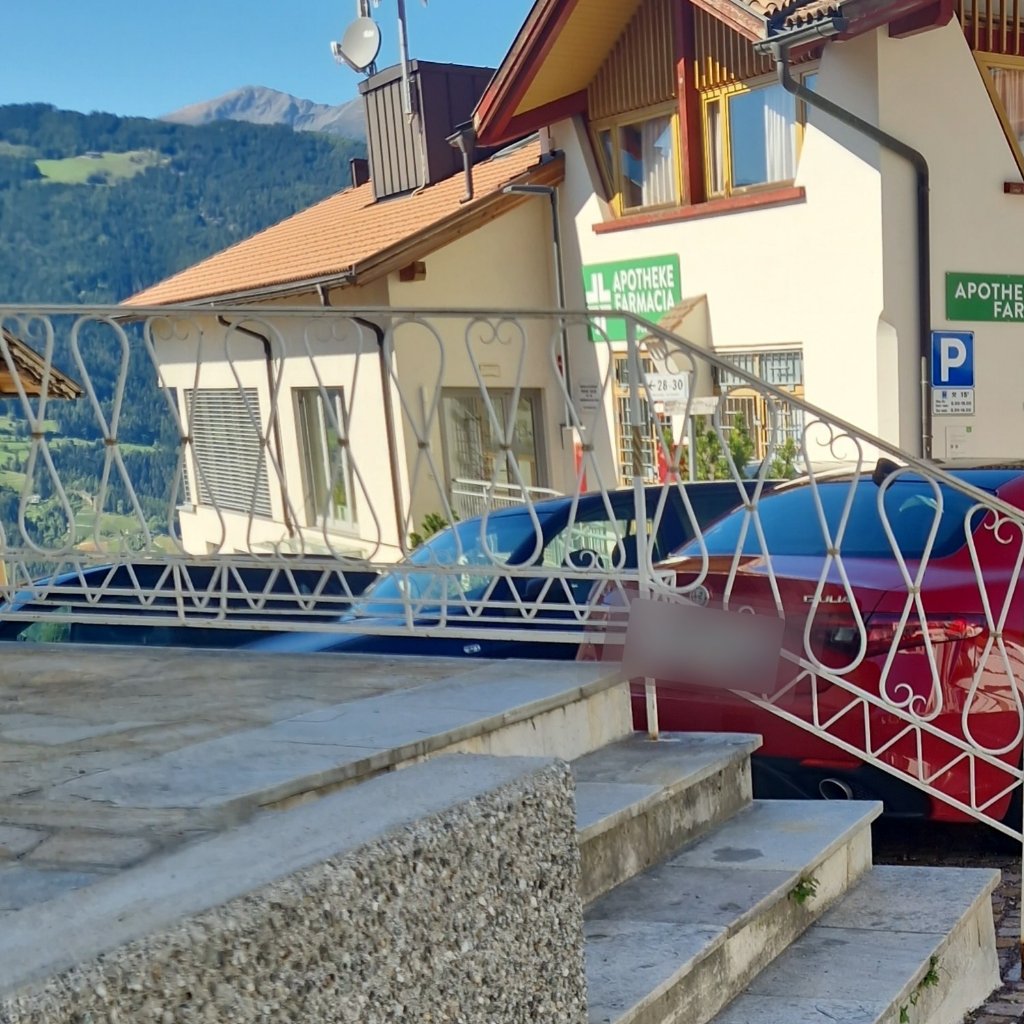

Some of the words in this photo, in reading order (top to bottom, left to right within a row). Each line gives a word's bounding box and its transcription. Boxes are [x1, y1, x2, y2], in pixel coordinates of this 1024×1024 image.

[613, 264, 675, 293] APOTHEKE
[614, 289, 675, 314] FARMACIA
[940, 338, 967, 382] P
